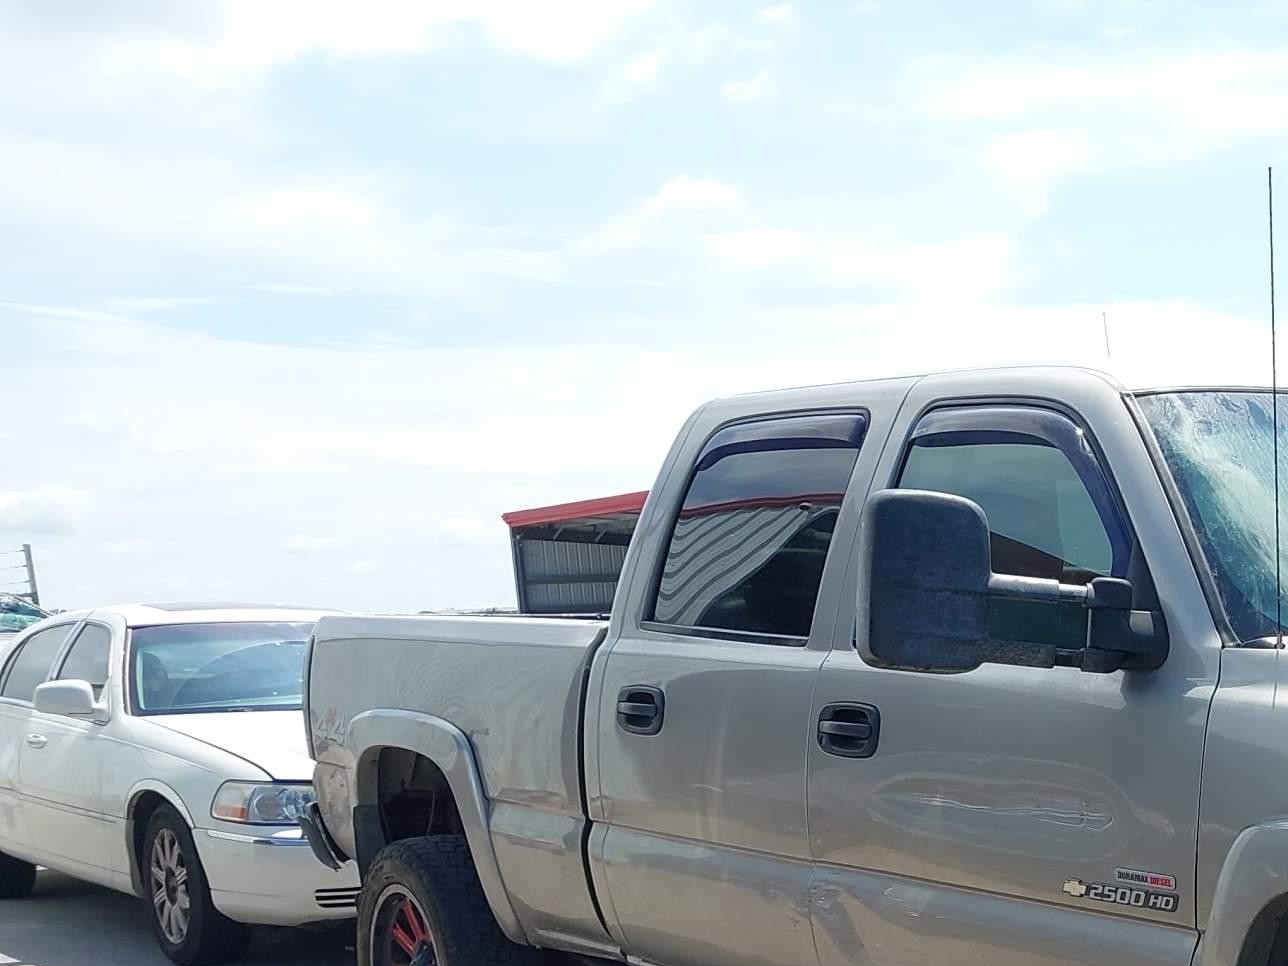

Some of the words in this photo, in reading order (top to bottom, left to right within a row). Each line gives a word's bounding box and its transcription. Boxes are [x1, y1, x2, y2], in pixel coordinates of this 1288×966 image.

[1117, 871, 1149, 884] DURAMAX
[1150, 876, 1173, 888] DIESEL
[1089, 884, 1145, 906] 2500
[1148, 894, 1174, 910] HD
